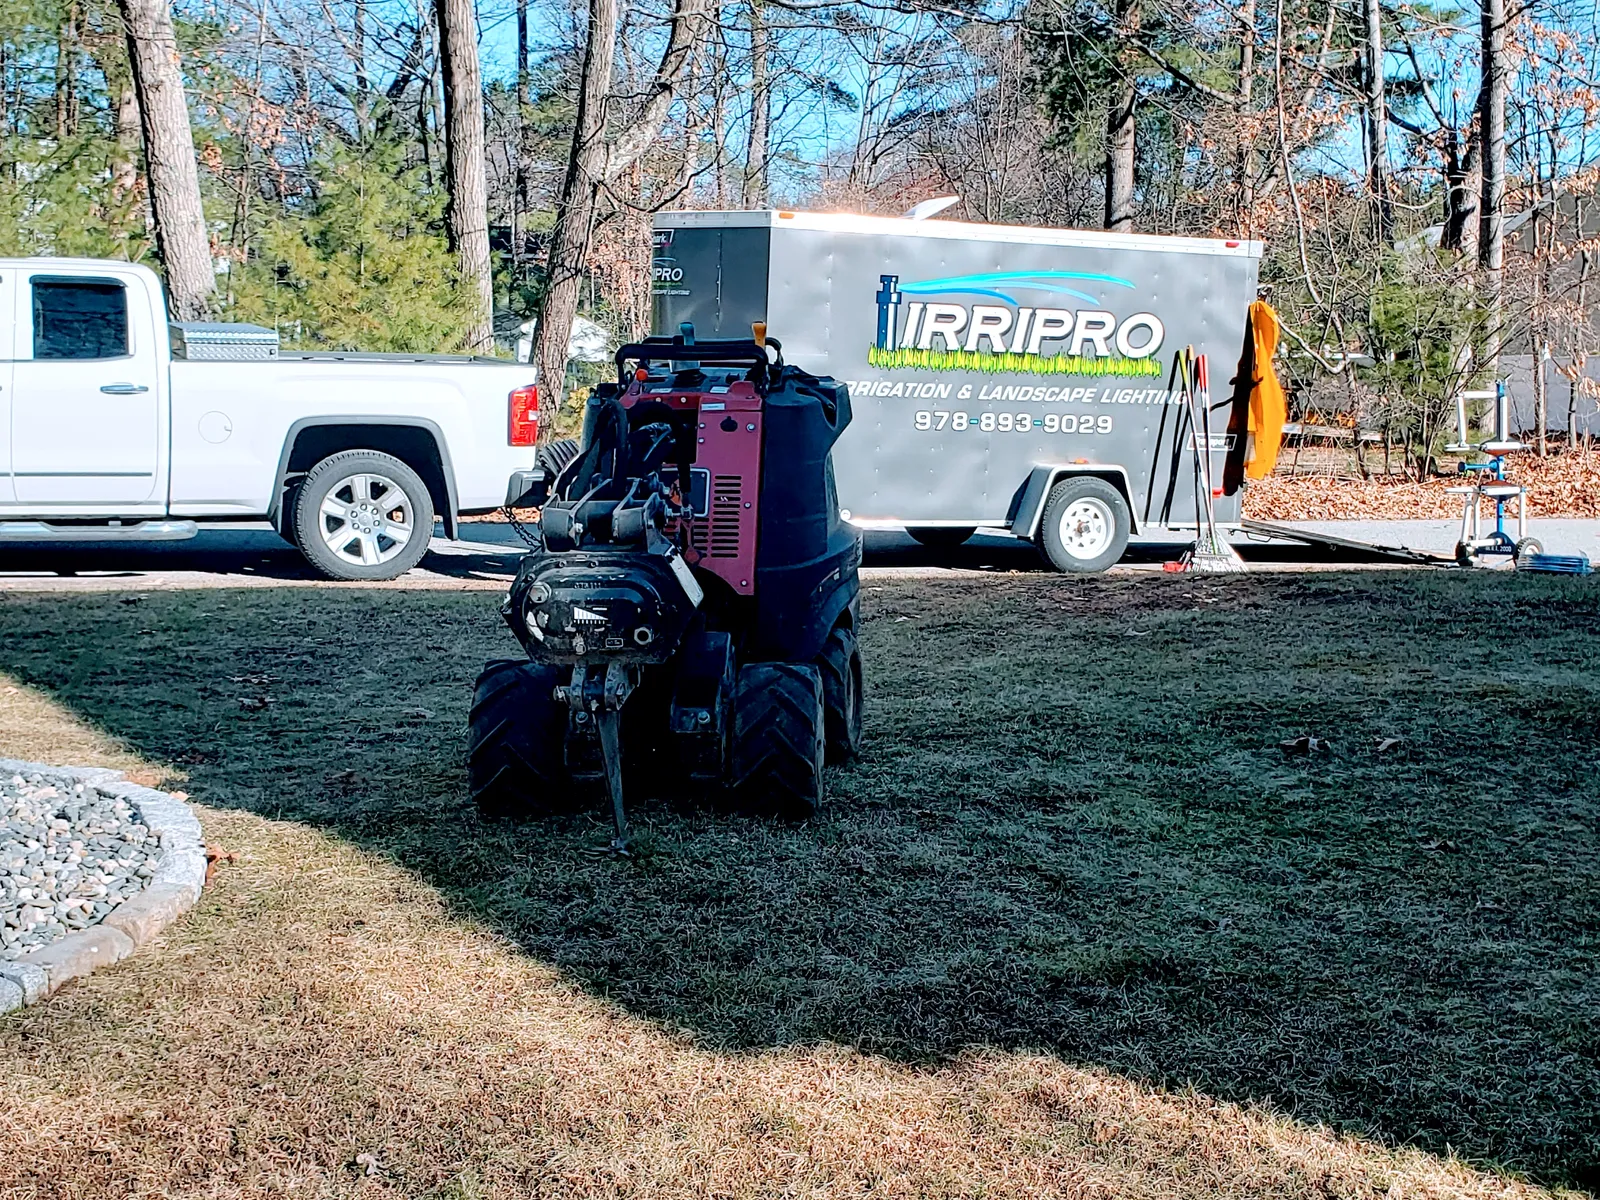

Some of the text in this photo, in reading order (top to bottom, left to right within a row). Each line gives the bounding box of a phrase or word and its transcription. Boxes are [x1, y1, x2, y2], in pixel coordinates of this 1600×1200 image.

[900, 301, 1166, 360] IRRIPRO
[844, 380, 1188, 406] RRIGATION & LANDSCAPE LIGHTING
[914, 410, 1114, 434] 978-893-9029
